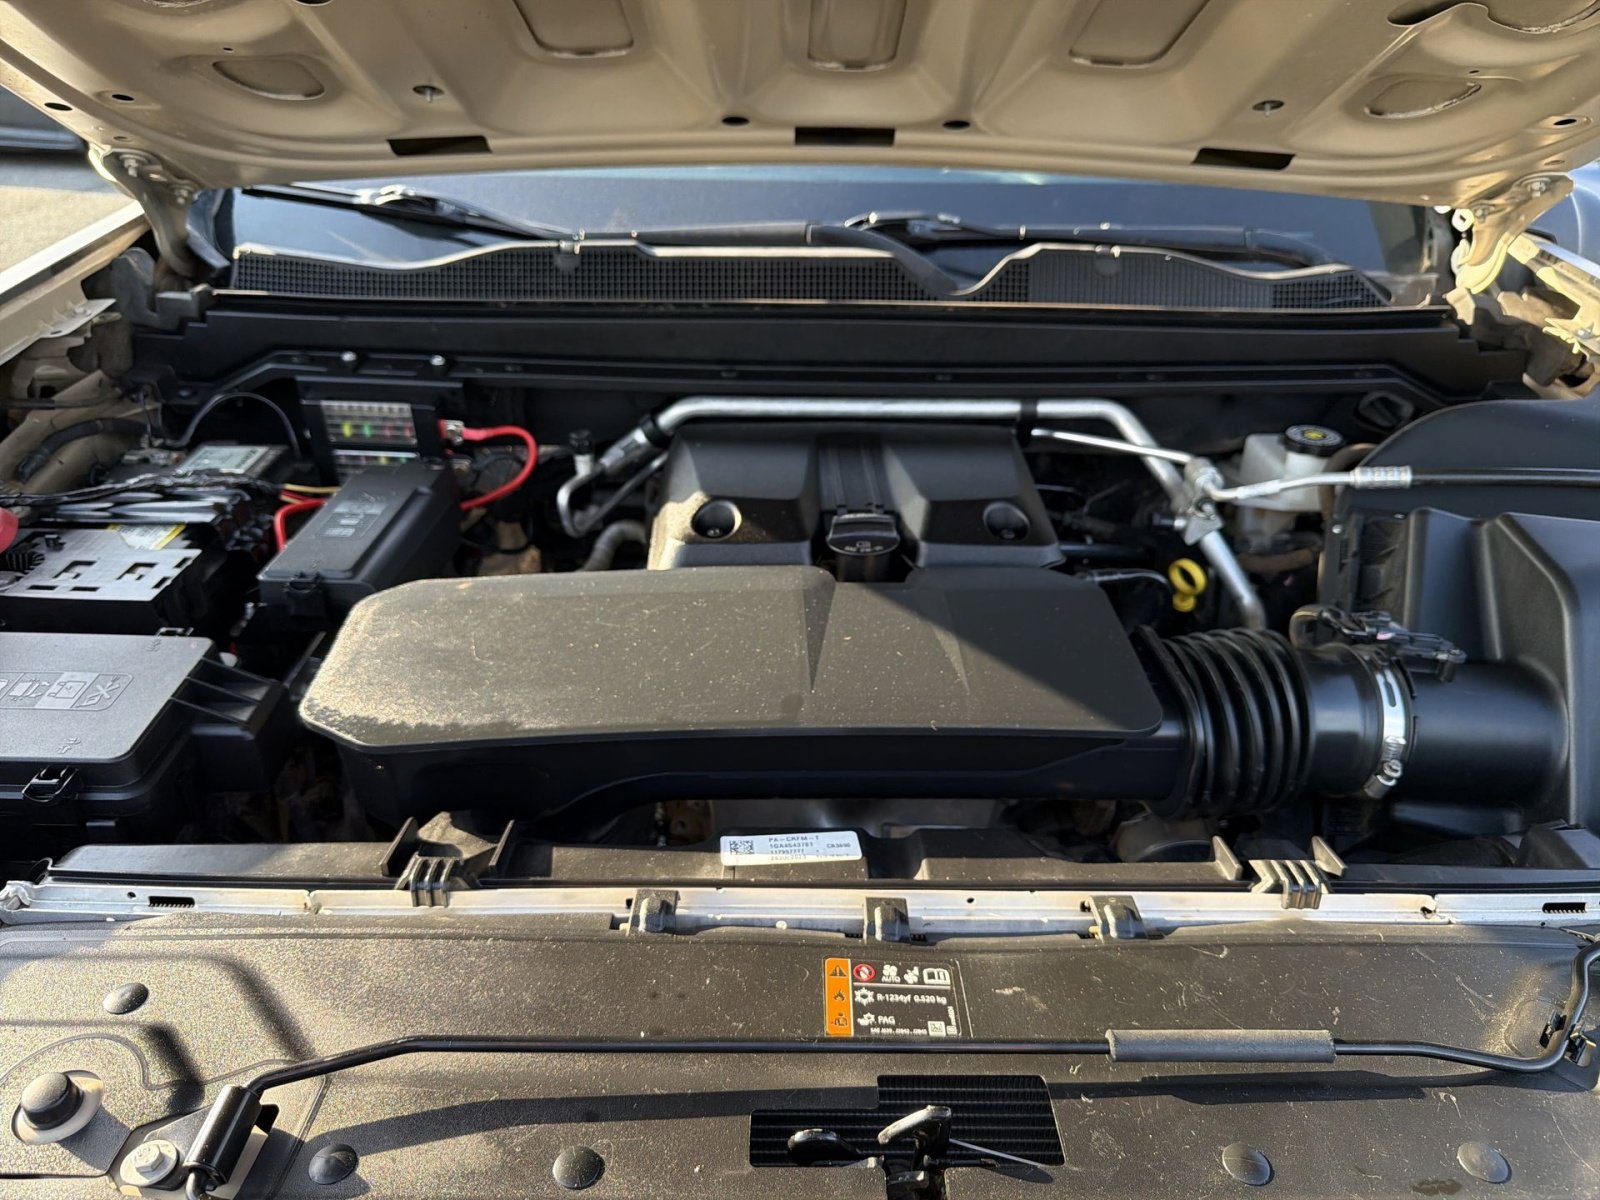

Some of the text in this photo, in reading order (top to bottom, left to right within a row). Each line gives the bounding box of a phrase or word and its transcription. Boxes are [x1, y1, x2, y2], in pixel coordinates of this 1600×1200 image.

[877, 993, 948, 1005] R-1234yf 0.520 kg
[878, 1015, 896, 1025] PAG
